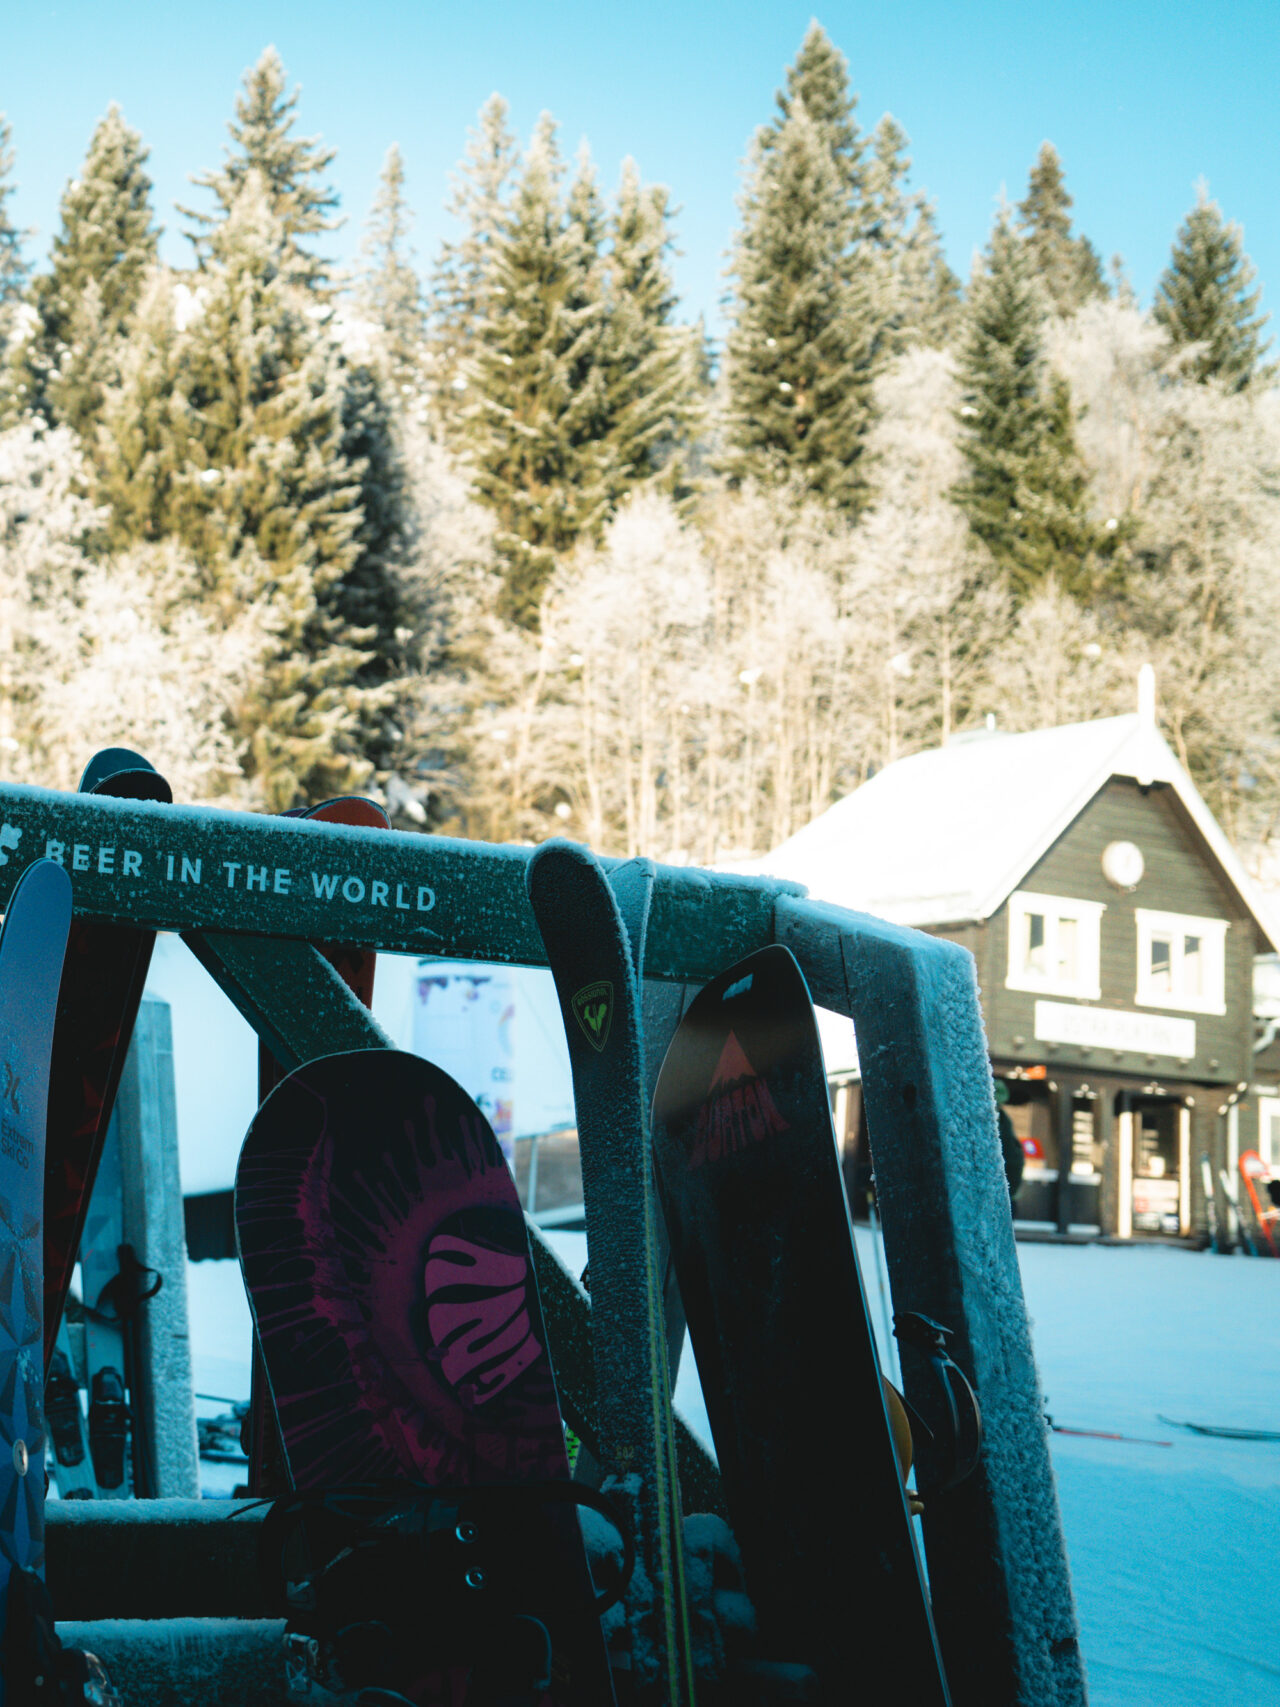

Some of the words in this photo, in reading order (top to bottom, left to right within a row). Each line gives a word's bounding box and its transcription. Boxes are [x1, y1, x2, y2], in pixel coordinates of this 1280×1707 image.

[45, 838, 144, 877] BEER
[166, 855, 202, 885] IN
[222, 861, 290, 895] THE
[311, 872, 436, 912] WORLD
